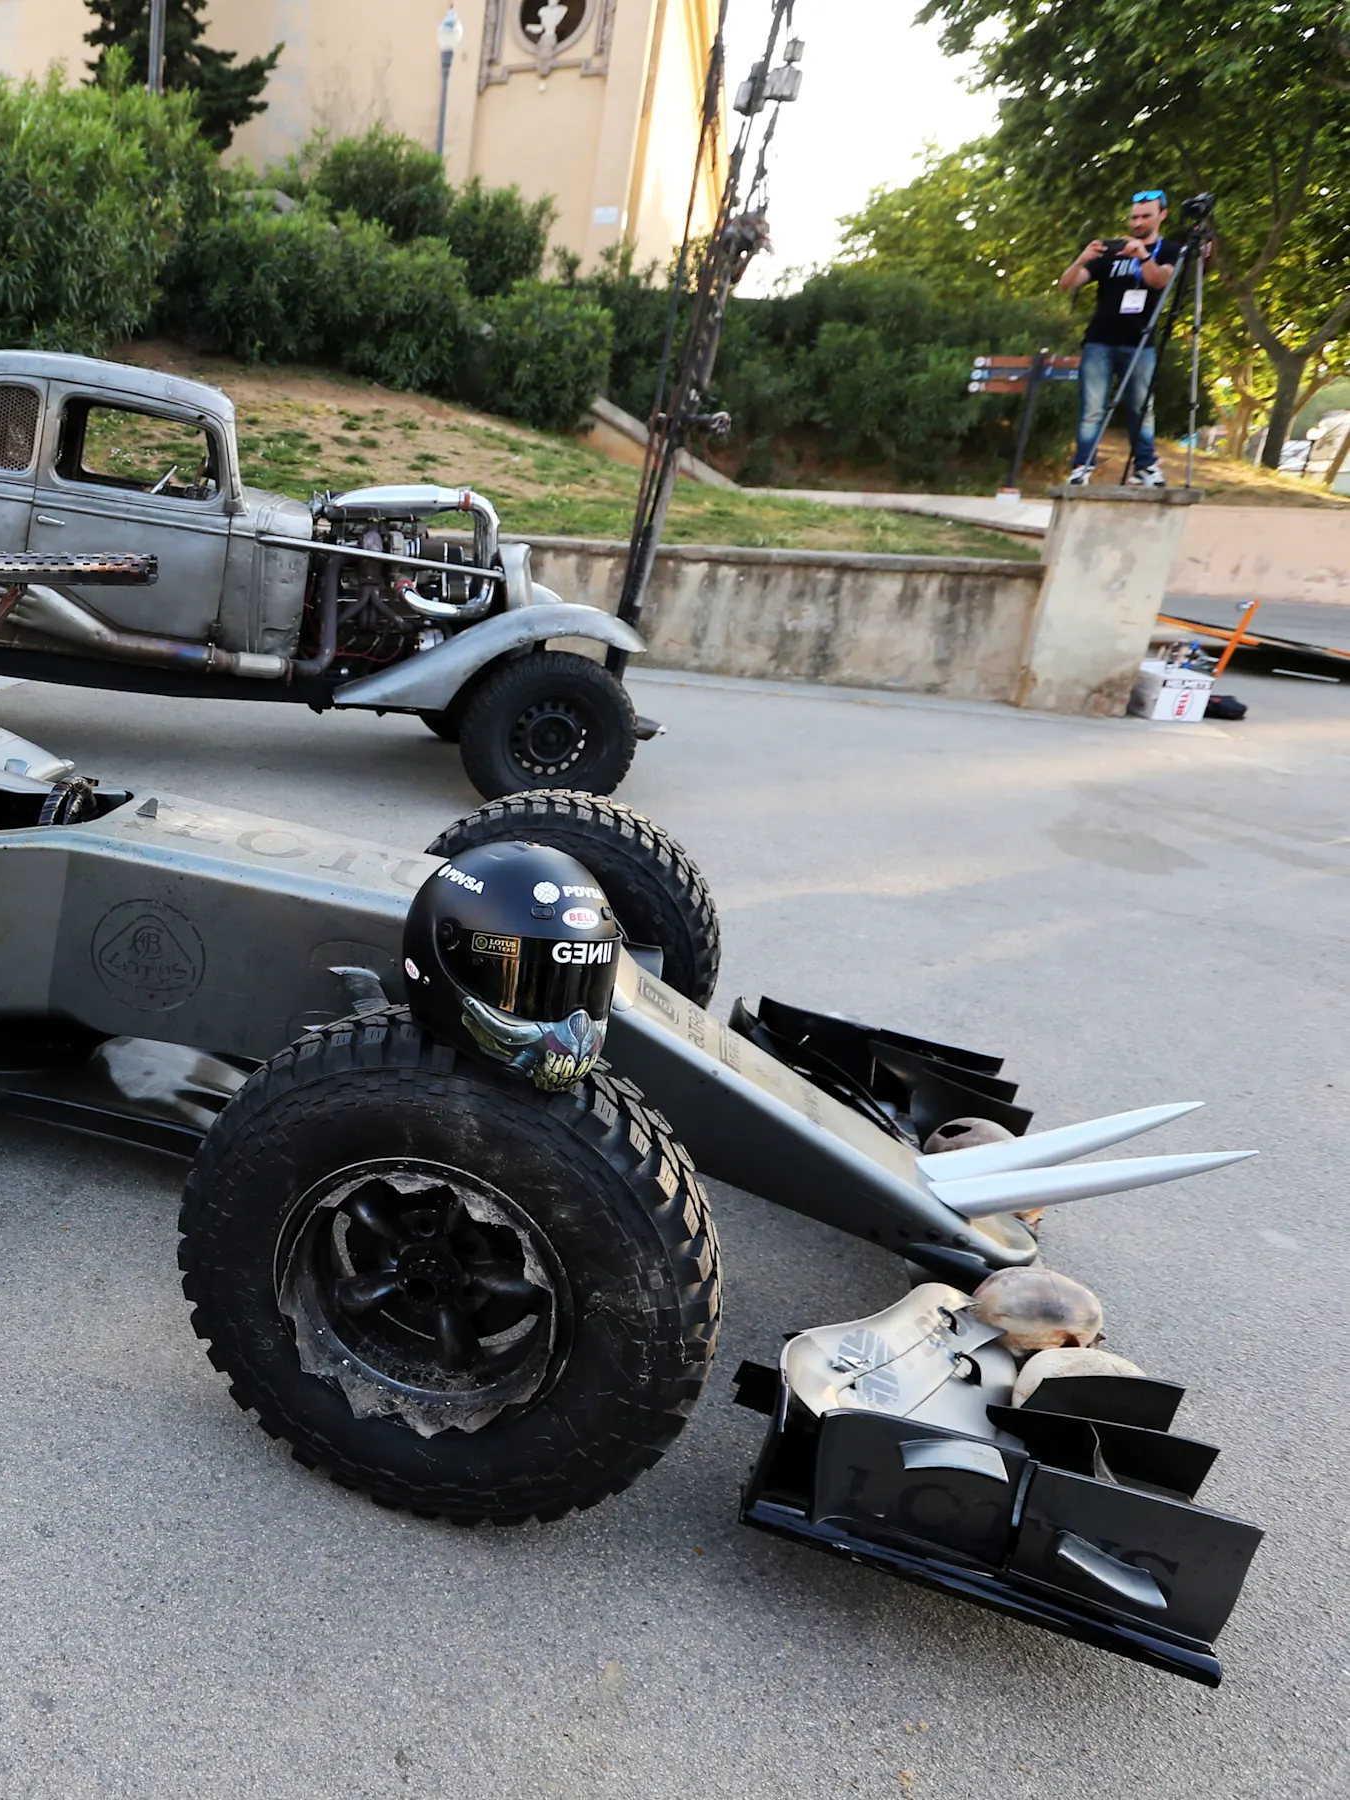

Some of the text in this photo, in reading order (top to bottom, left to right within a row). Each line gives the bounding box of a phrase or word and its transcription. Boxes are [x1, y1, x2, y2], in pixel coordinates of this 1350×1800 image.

[444, 868, 485, 895] PDVSA
[562, 885, 605, 901] PDVSA
[568, 912, 595, 922] BELL
[489, 938, 517, 947] LOTUS
[107, 951, 188, 985] LOTUS
